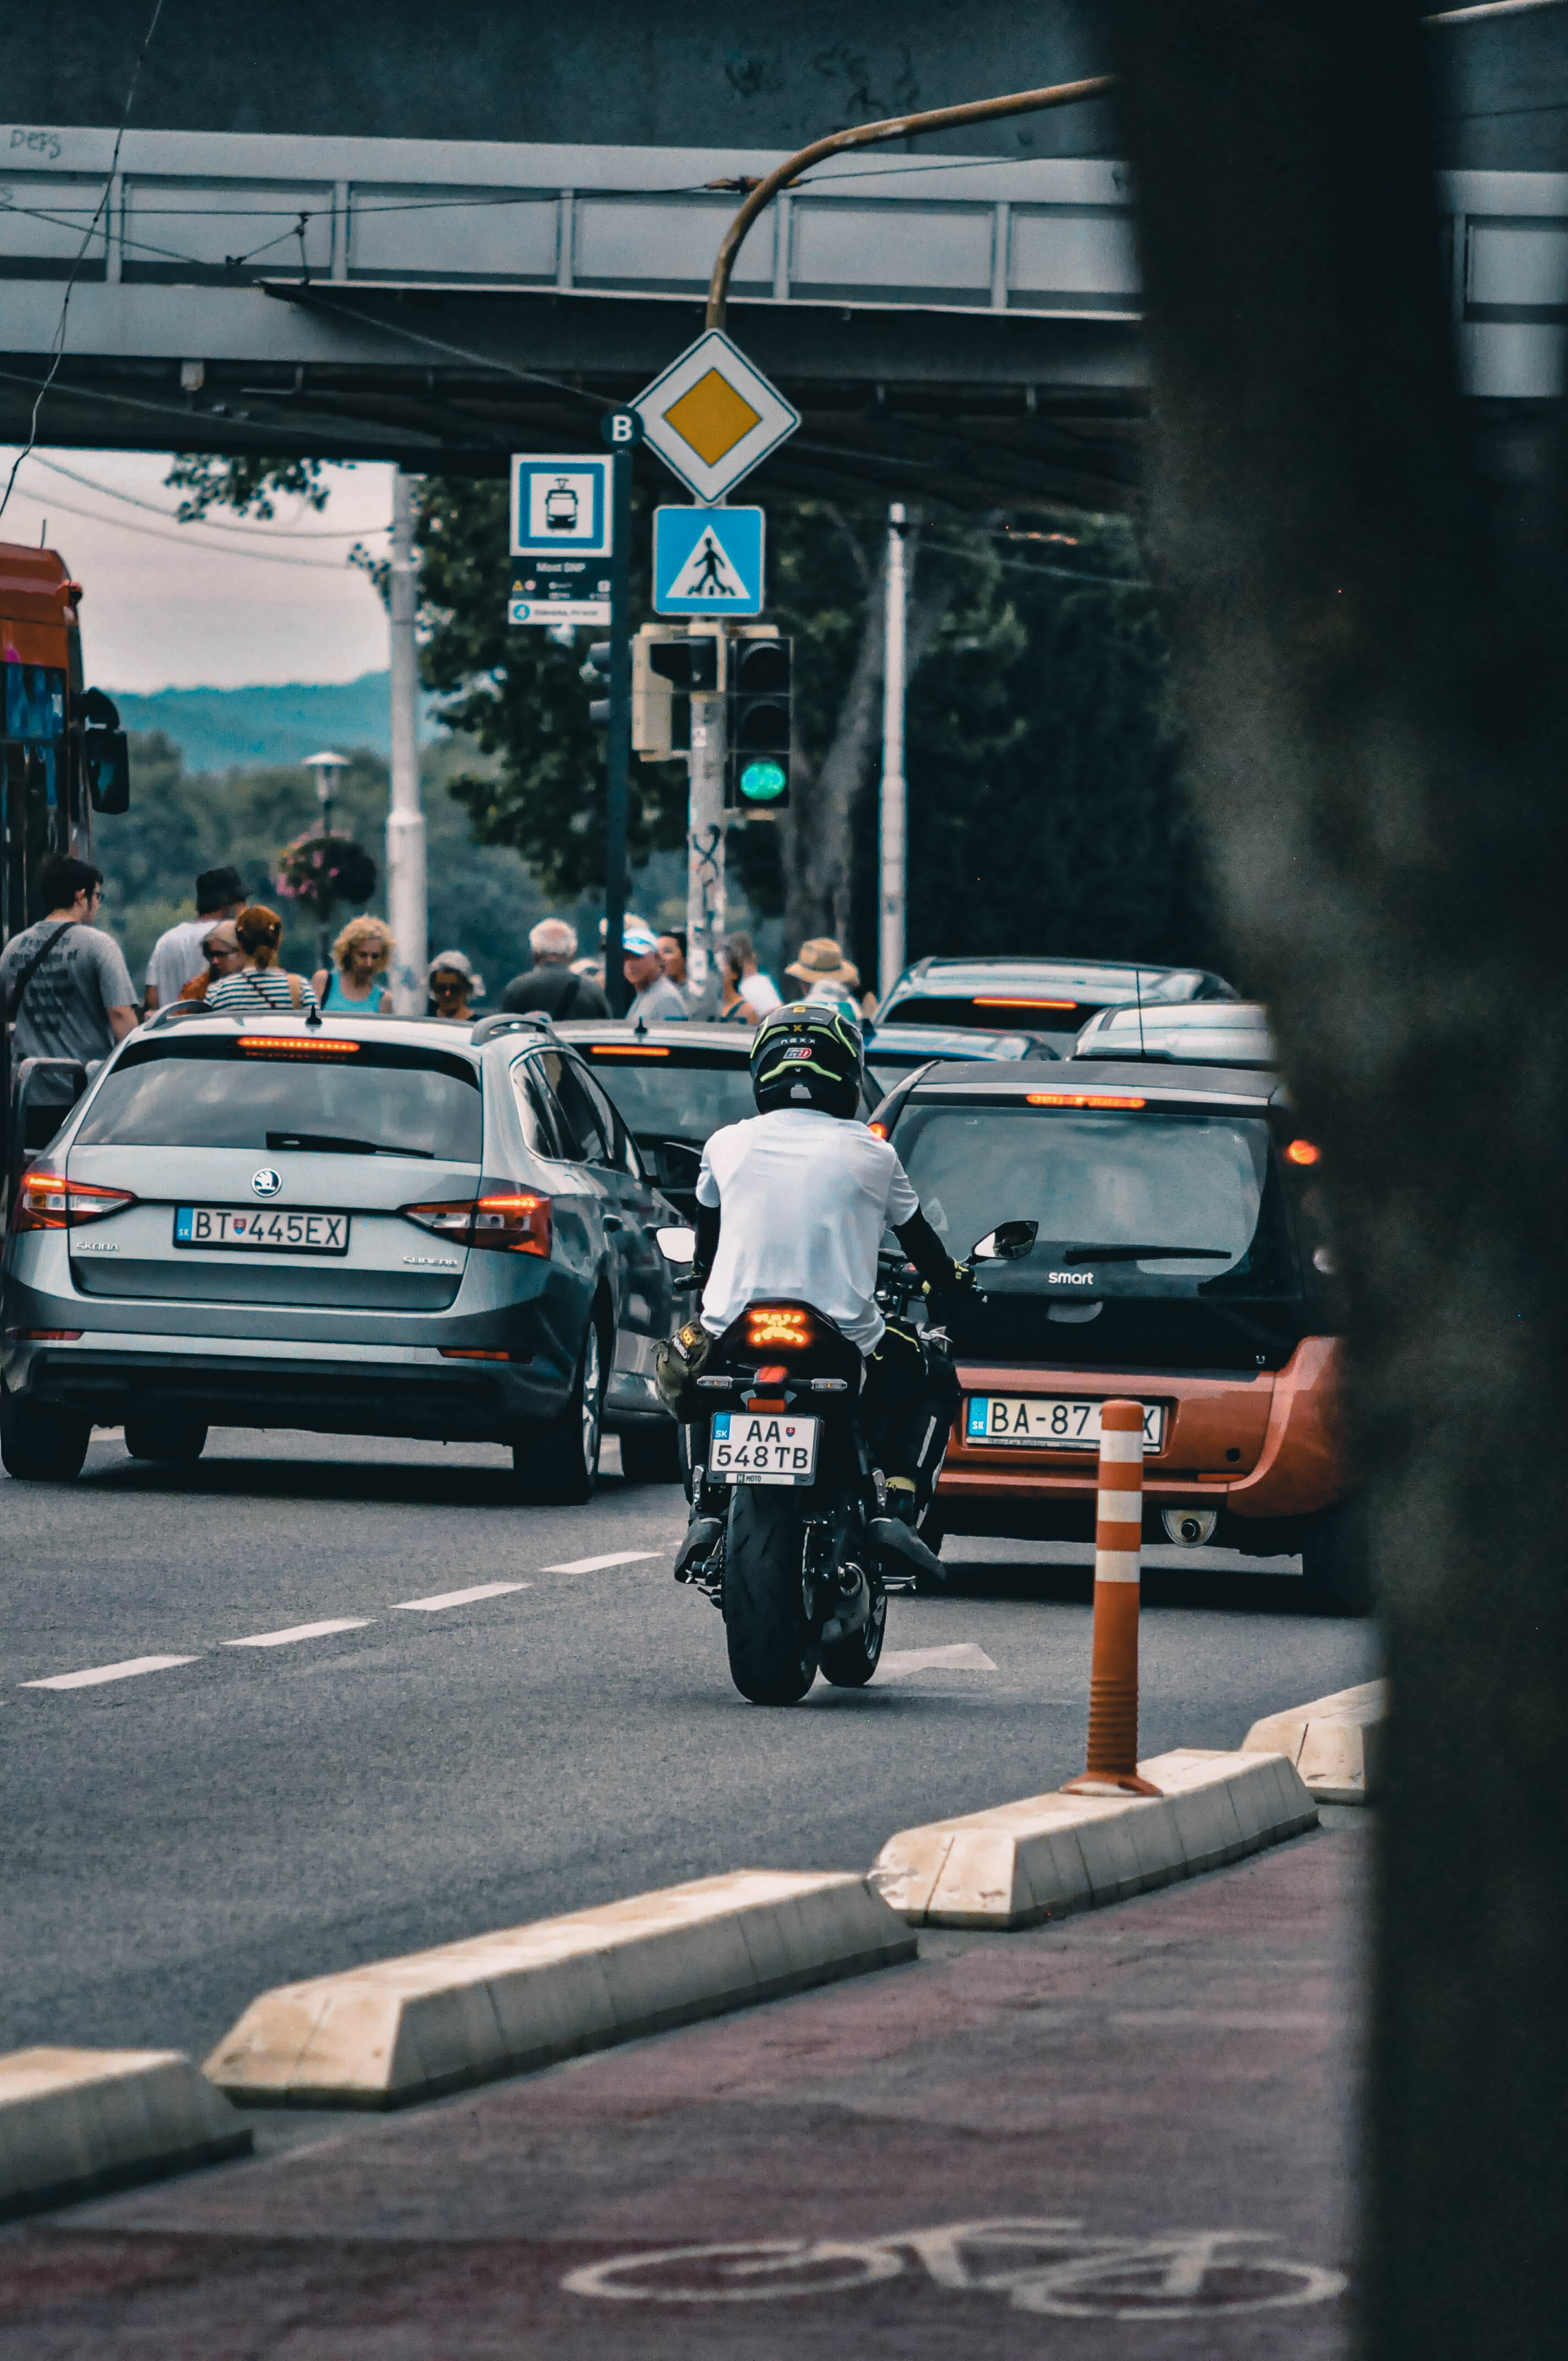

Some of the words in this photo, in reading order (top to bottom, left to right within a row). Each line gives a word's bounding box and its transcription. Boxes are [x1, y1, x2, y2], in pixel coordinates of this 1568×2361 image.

[612, 415, 633, 442] B
[195, 1211, 232, 1239] BT
[249, 1214, 341, 1246] 445EX
[1048, 1272, 1094, 1285] smart
[746, 1420, 780, 1442] AA
[972, 1421, 984, 1430] SK
